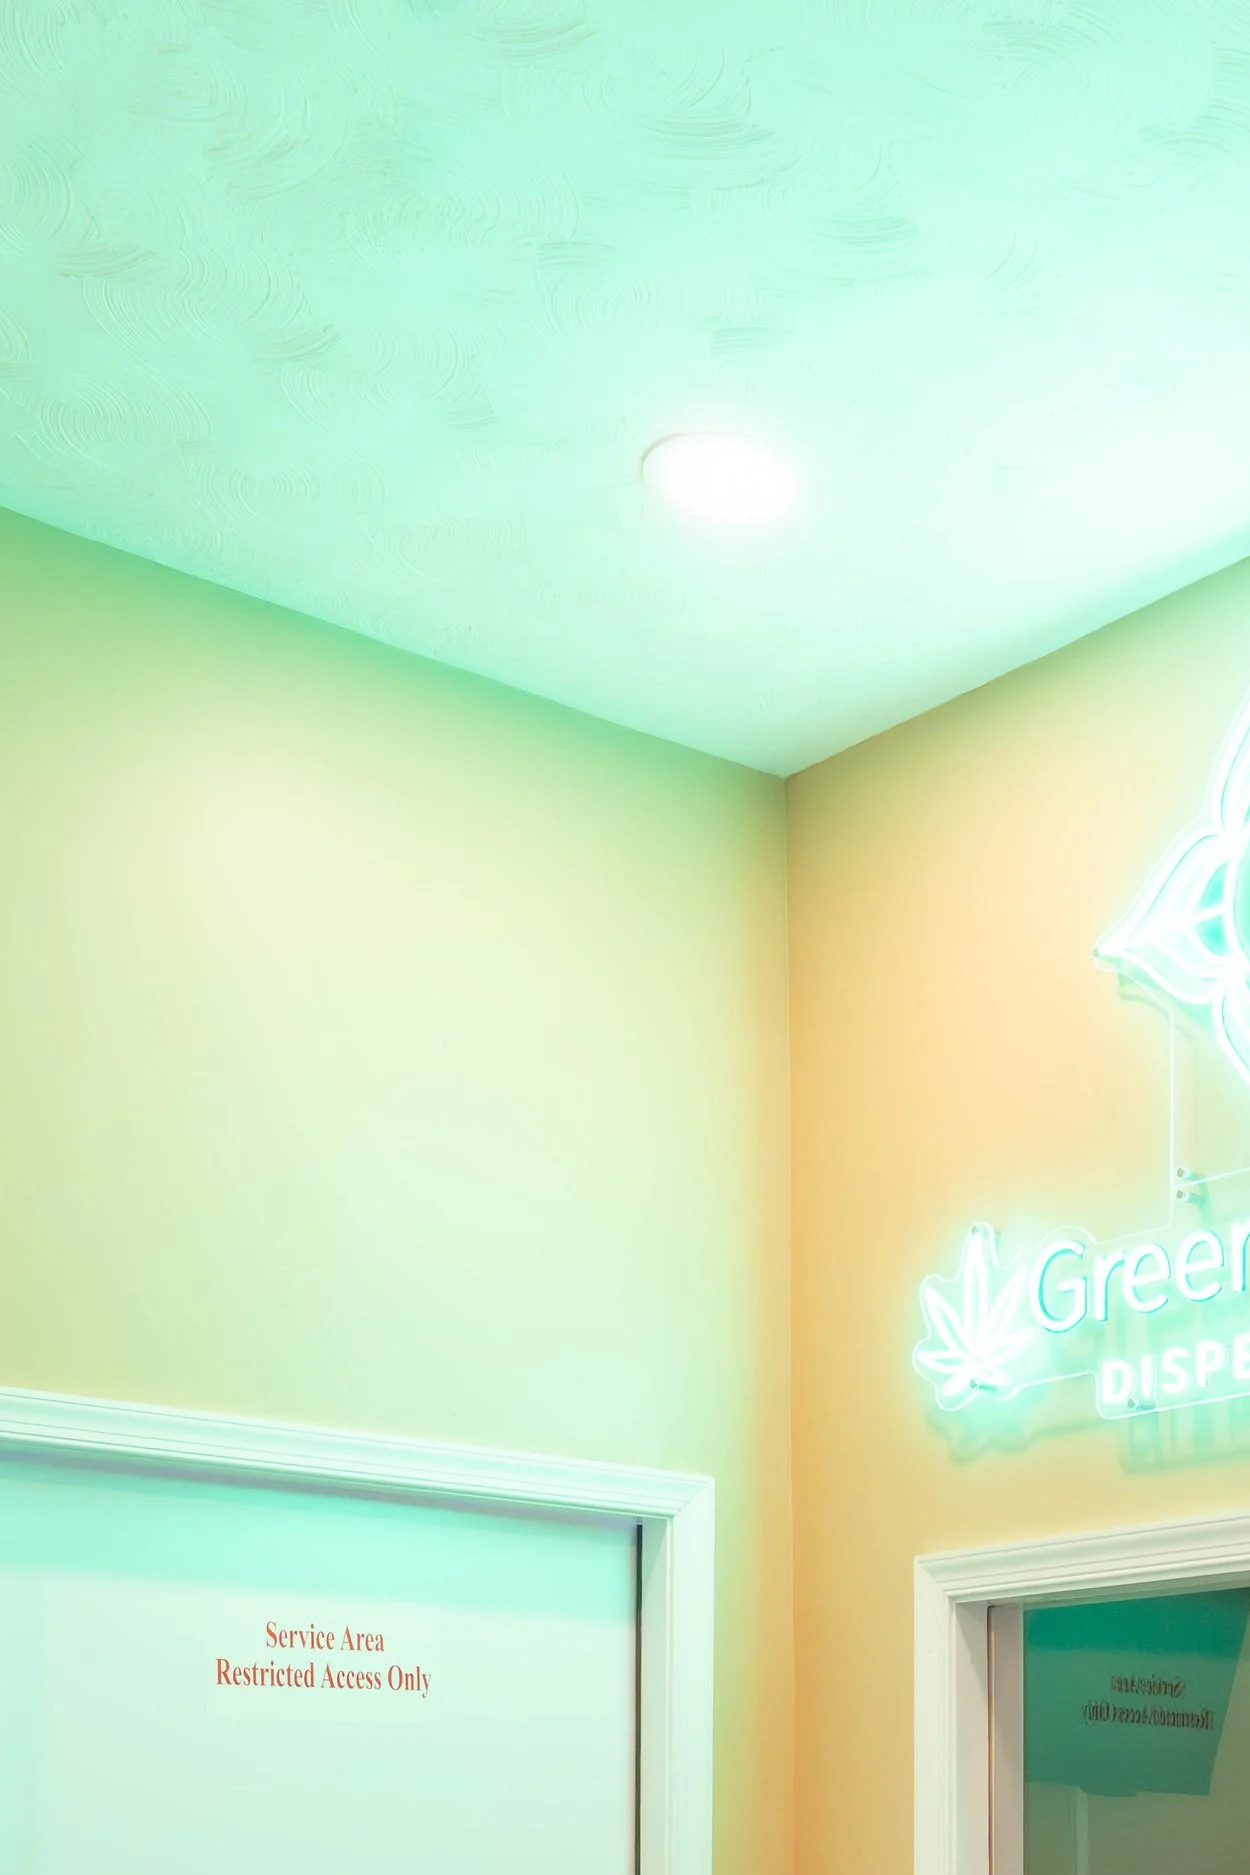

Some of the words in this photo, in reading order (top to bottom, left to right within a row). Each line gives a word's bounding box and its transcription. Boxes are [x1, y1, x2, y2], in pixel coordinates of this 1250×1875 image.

[266, 1621, 335, 1650] Service
[340, 1626, 385, 1651] Area
[216, 1658, 314, 1688] Restricted
[321, 1664, 382, 1690] Access
[387, 1665, 431, 1699] Only
